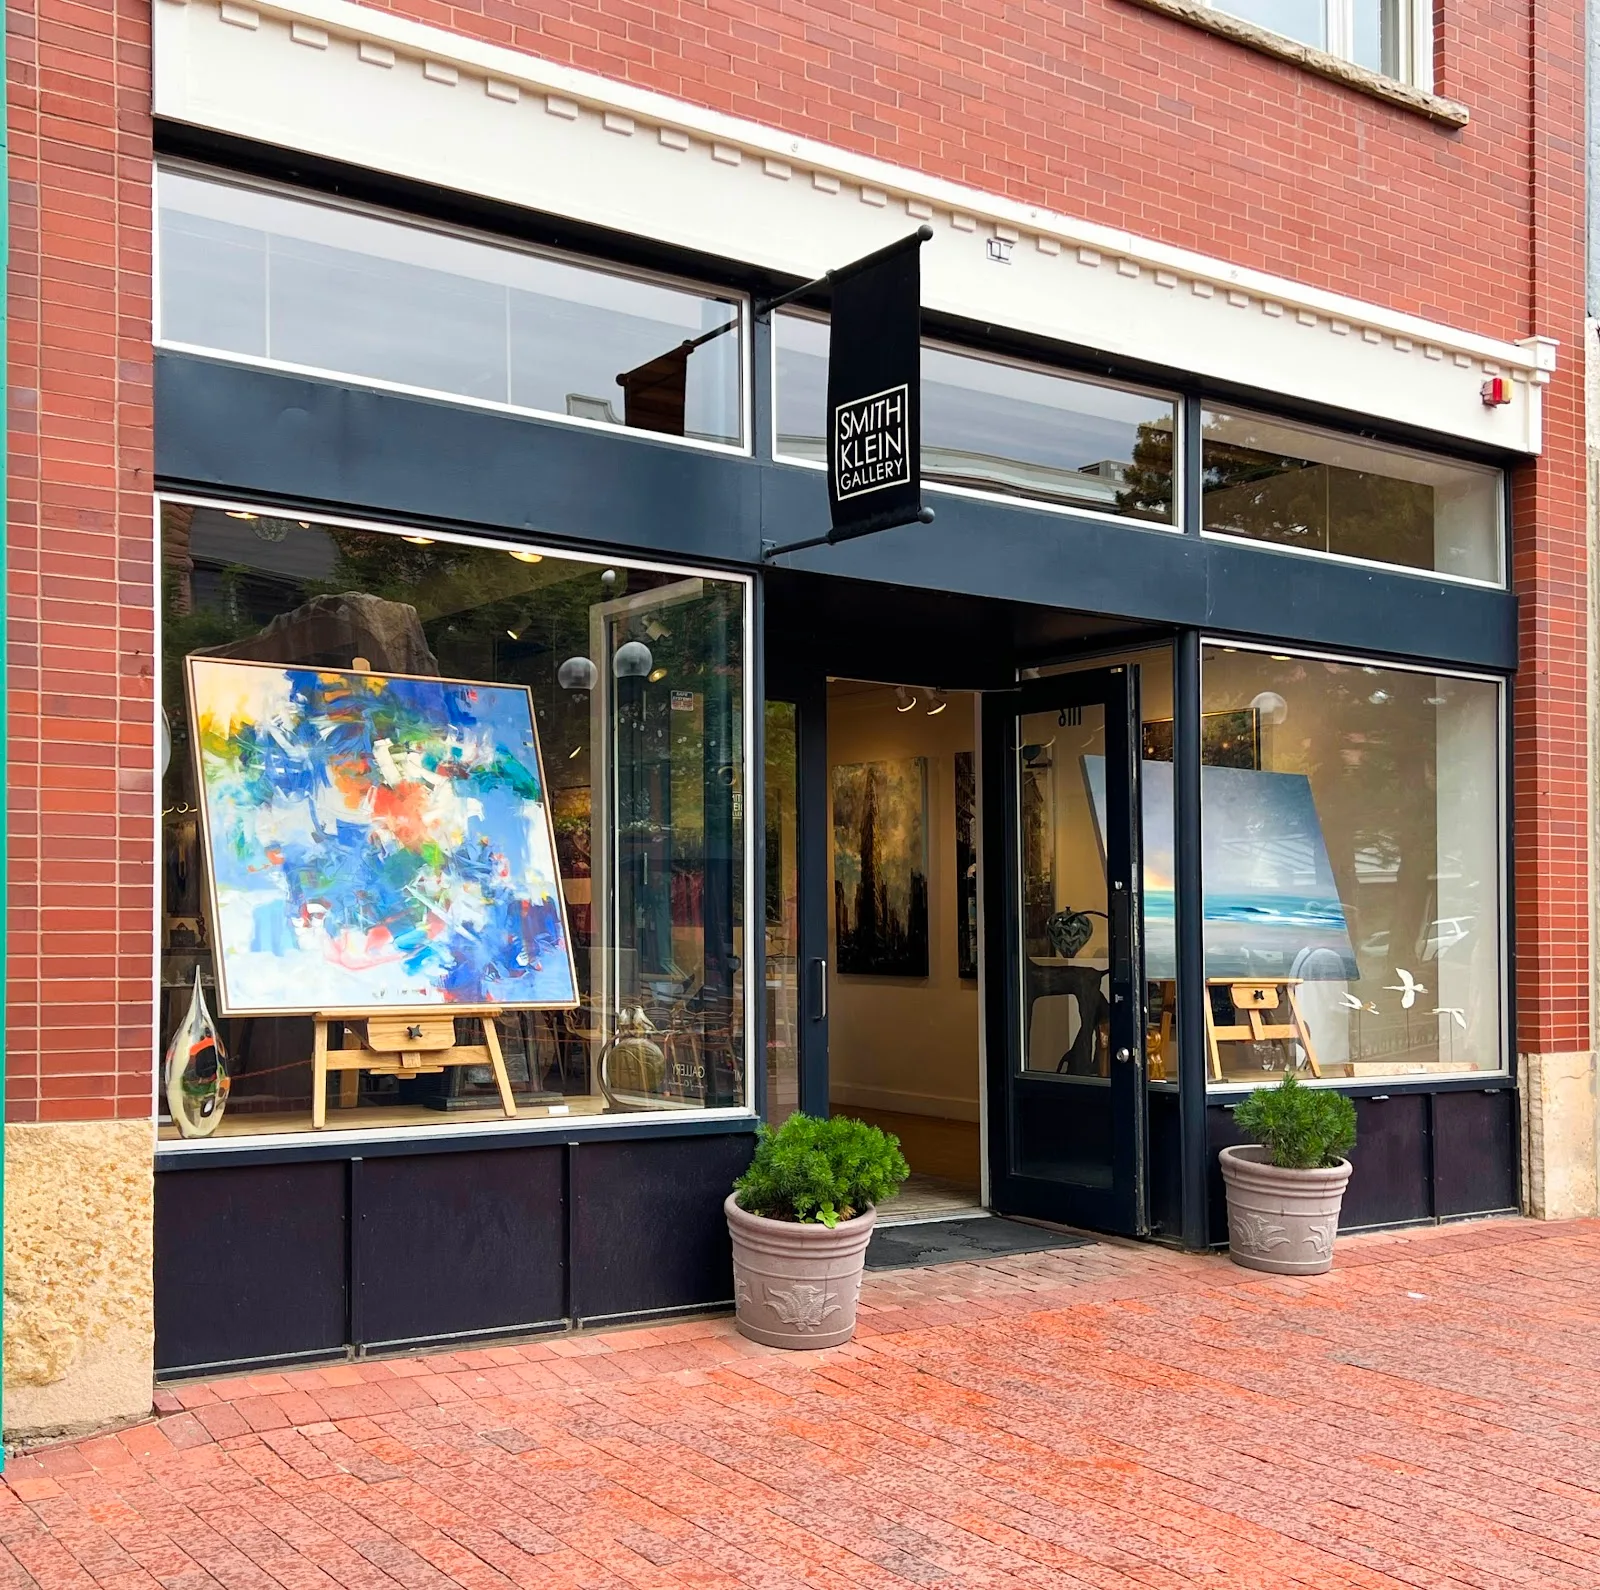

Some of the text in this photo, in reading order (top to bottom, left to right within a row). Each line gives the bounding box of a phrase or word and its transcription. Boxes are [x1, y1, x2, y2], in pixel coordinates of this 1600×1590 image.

[840, 395, 901, 440] SMITH
[841, 427, 902, 471] KLEIN
[840, 458, 903, 490] GALLERY
